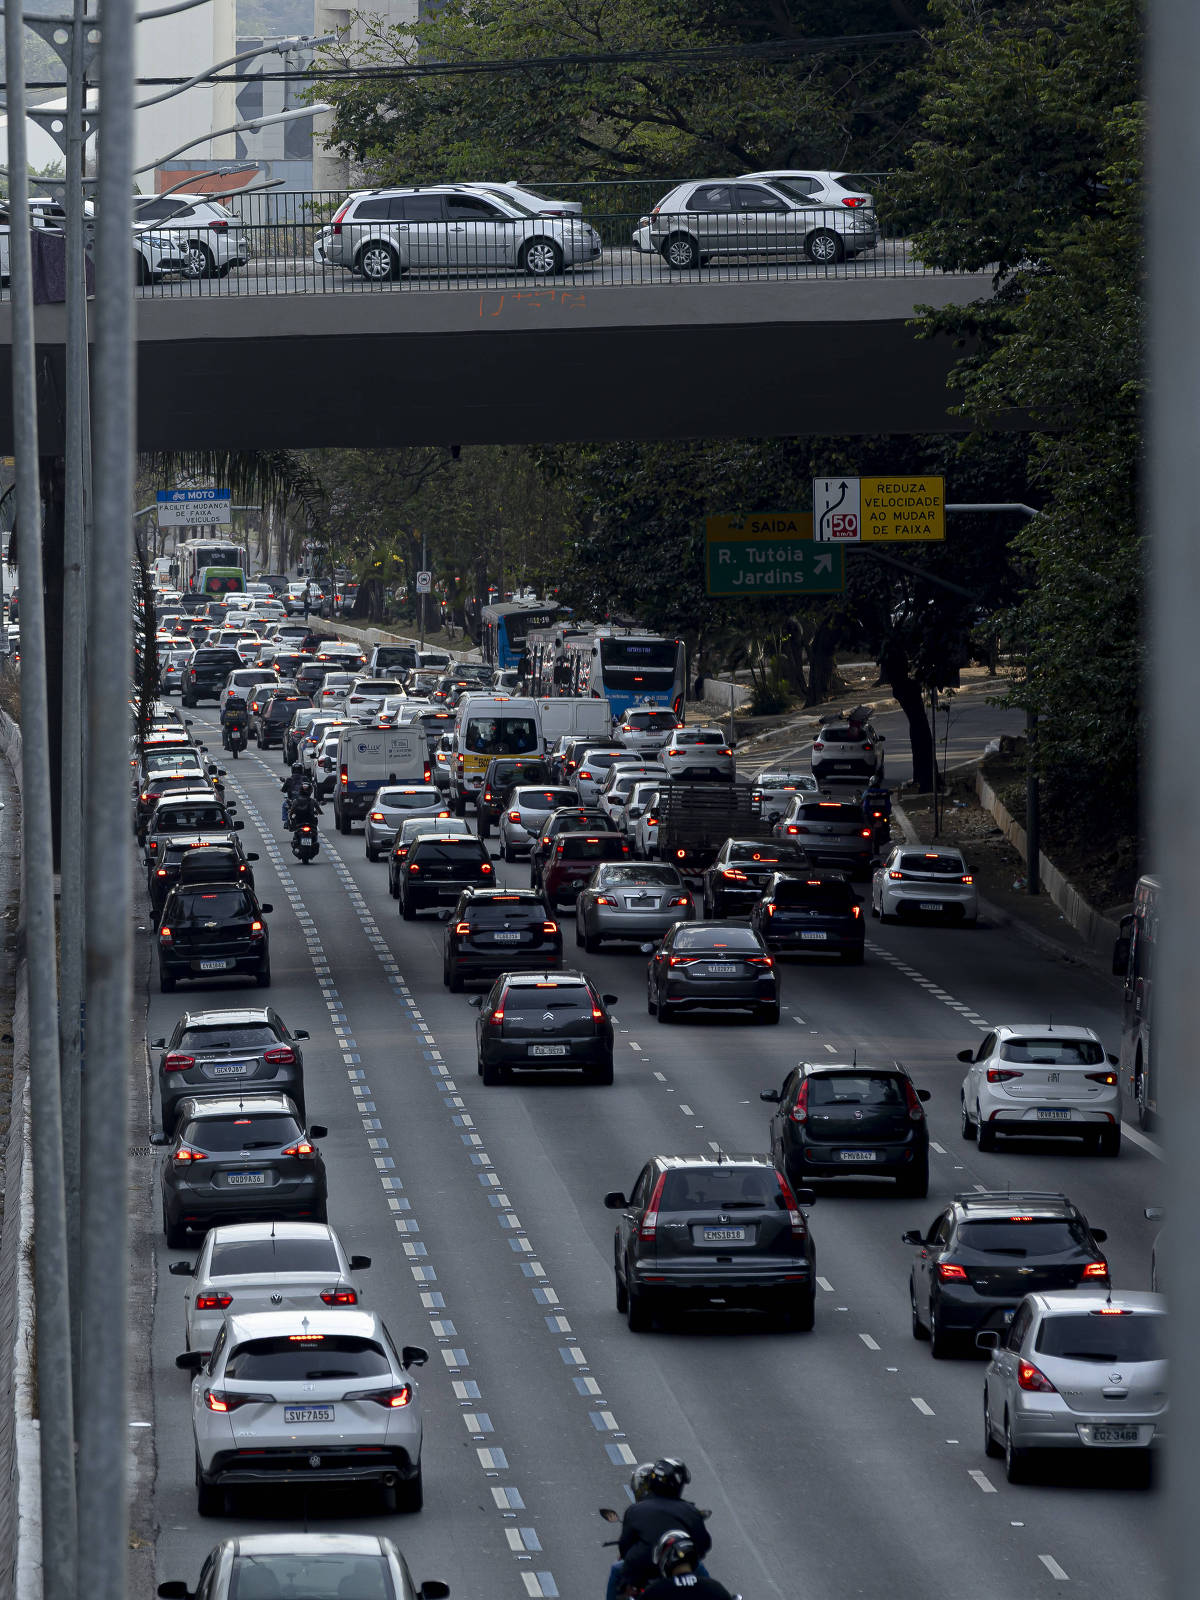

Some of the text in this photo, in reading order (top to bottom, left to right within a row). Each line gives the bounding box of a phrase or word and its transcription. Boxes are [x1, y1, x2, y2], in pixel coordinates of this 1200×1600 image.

[877, 482, 926, 494] REDUZA
[187, 490, 215, 499] MOTO
[864, 496, 940, 508] VELOCIDADE
[870, 510, 935, 521] AO MUDAR
[751, 518, 798, 534] SAÍDA
[833, 515, 857, 531] 50
[873, 524, 932, 535] DE FAIXA
[718, 547, 804, 564] R. Tutóia
[732, 568, 805, 585] Jardins
[289, 1410, 330, 1421] SVF7A55
